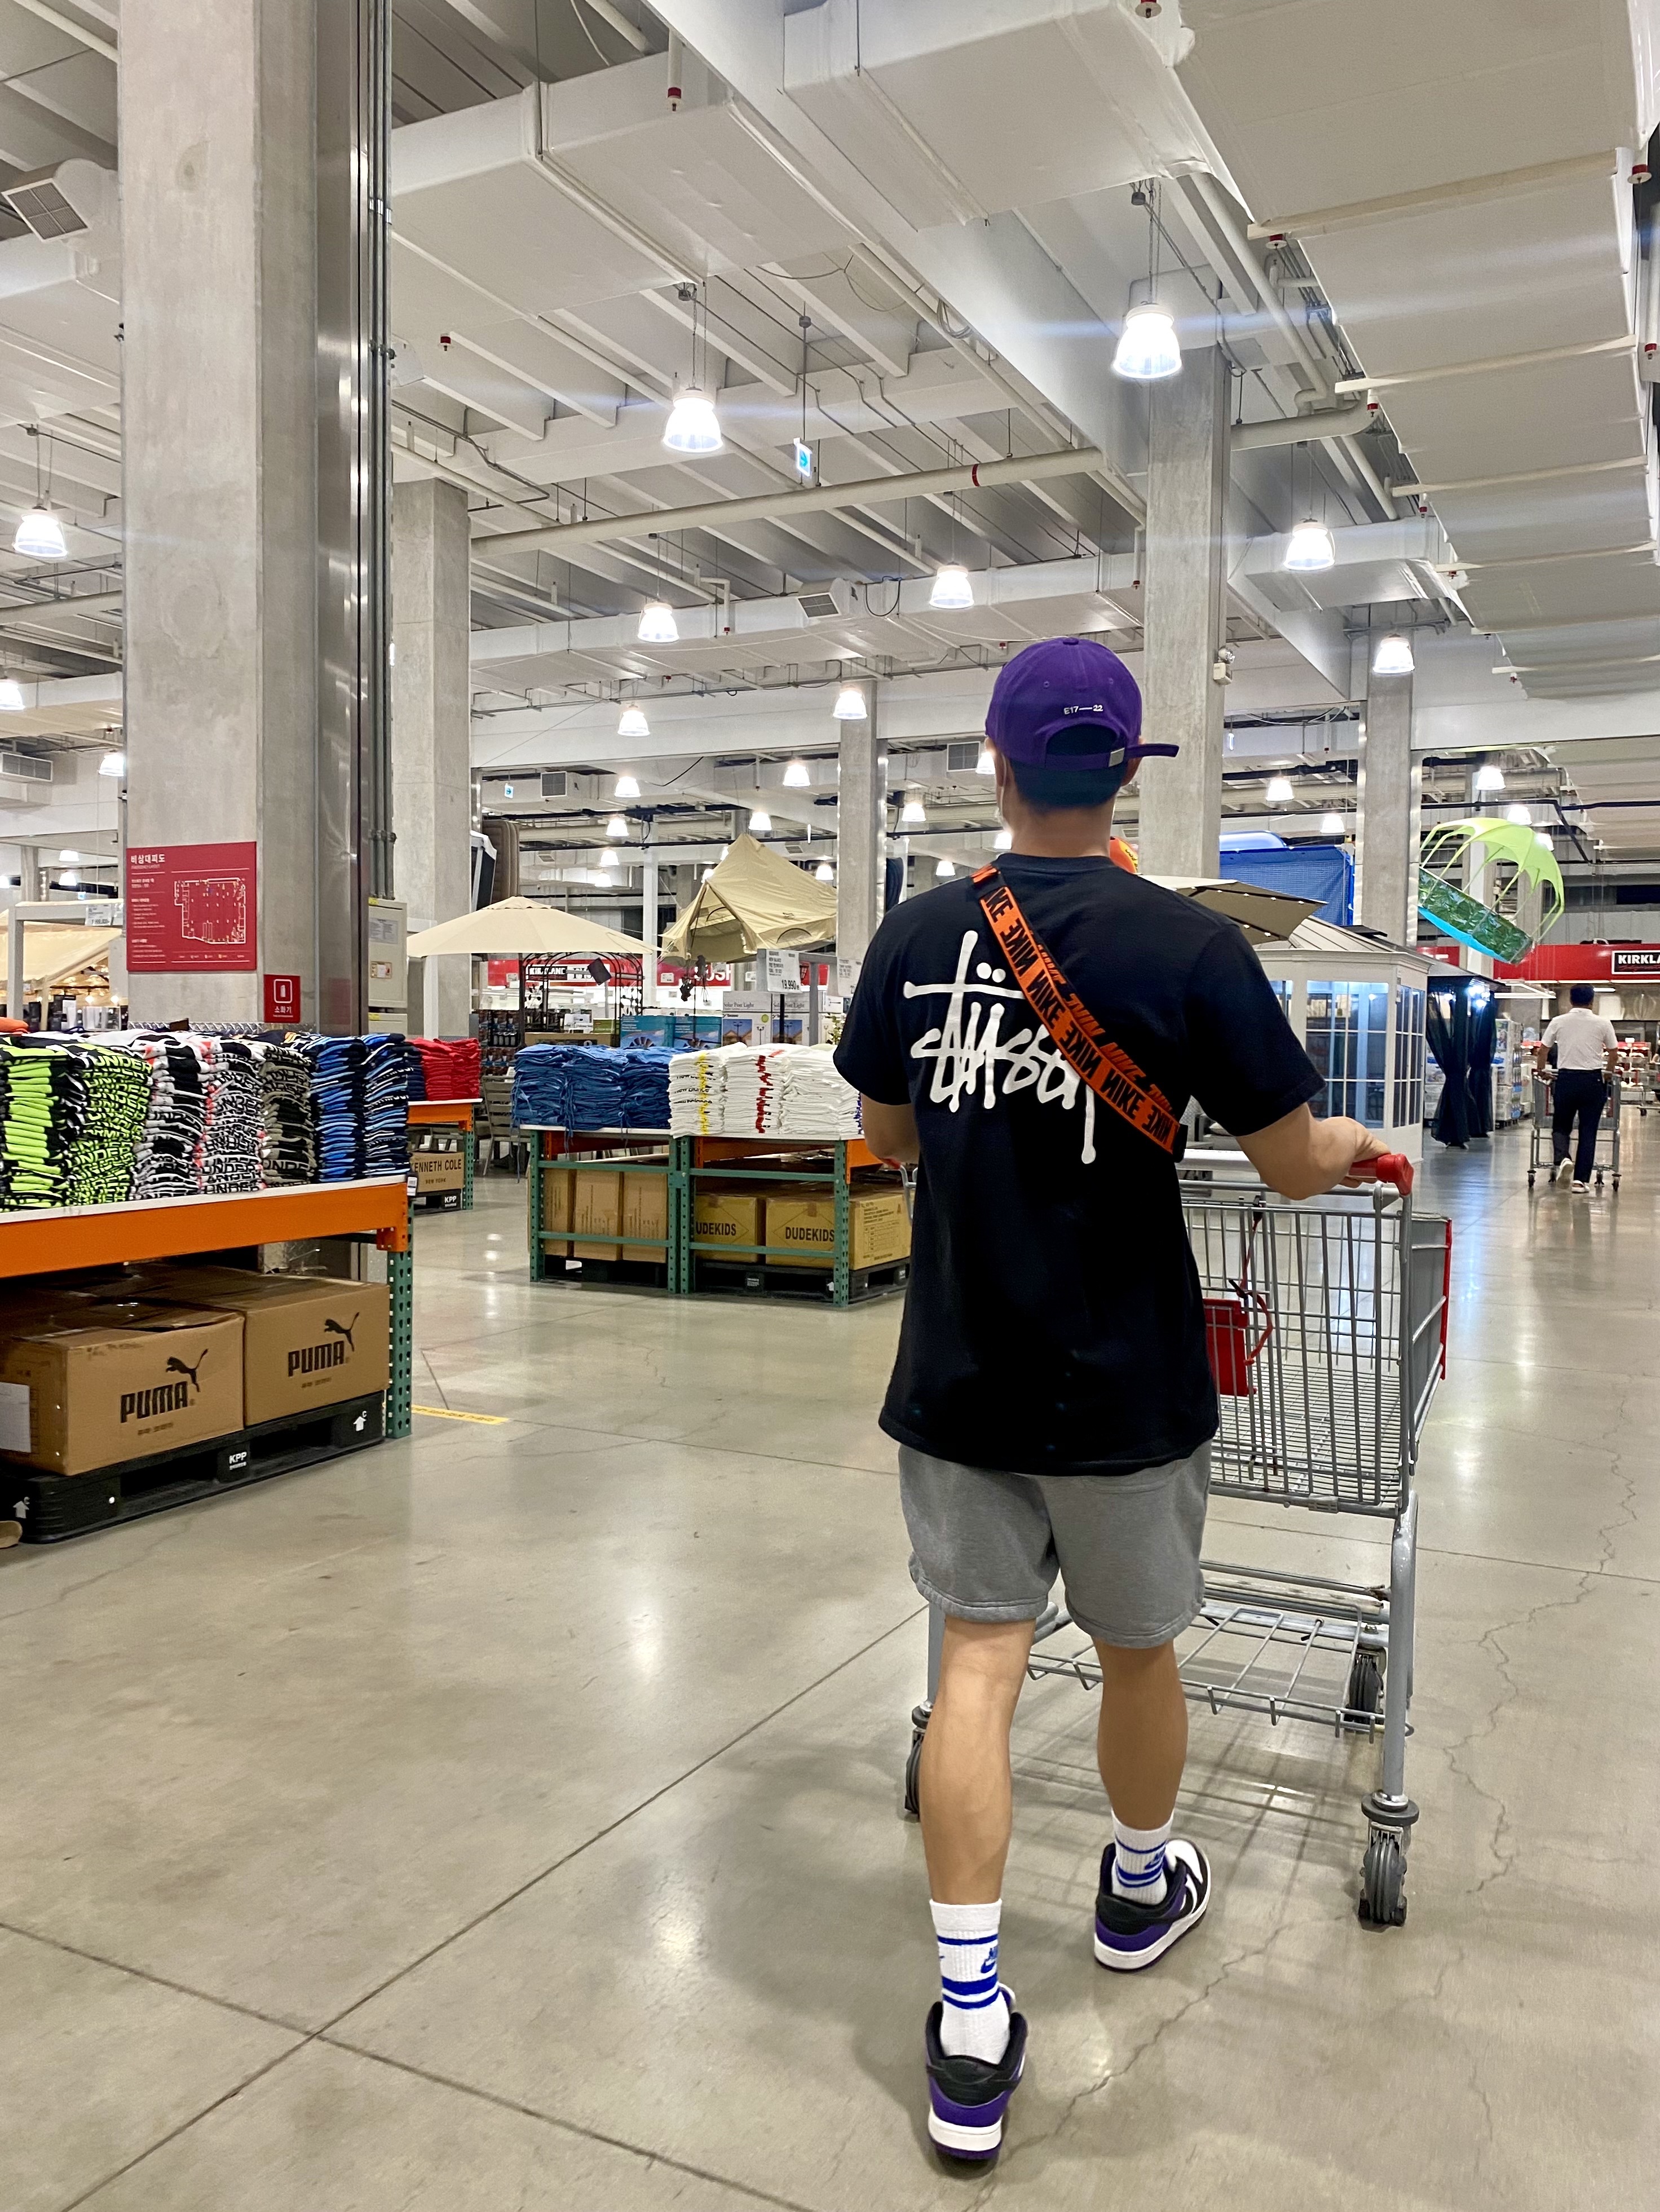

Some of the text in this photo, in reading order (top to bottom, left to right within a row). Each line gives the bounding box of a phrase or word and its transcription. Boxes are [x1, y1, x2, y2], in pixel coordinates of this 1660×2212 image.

[131, 853, 165, 864] 비상대피도
[1026, 970, 1066, 1030] NIKE
[1059, 1021, 1103, 1080] NIKE
[1100, 1068, 1145, 1120] NIKE
[445, 1159, 462, 1171] COLE
[785, 1227, 835, 1242] DUDEKIDS
[288, 1340, 345, 1377] PUMA
[120, 1381, 188, 1423] PUMA
[229, 1451, 247, 1464] KPP
